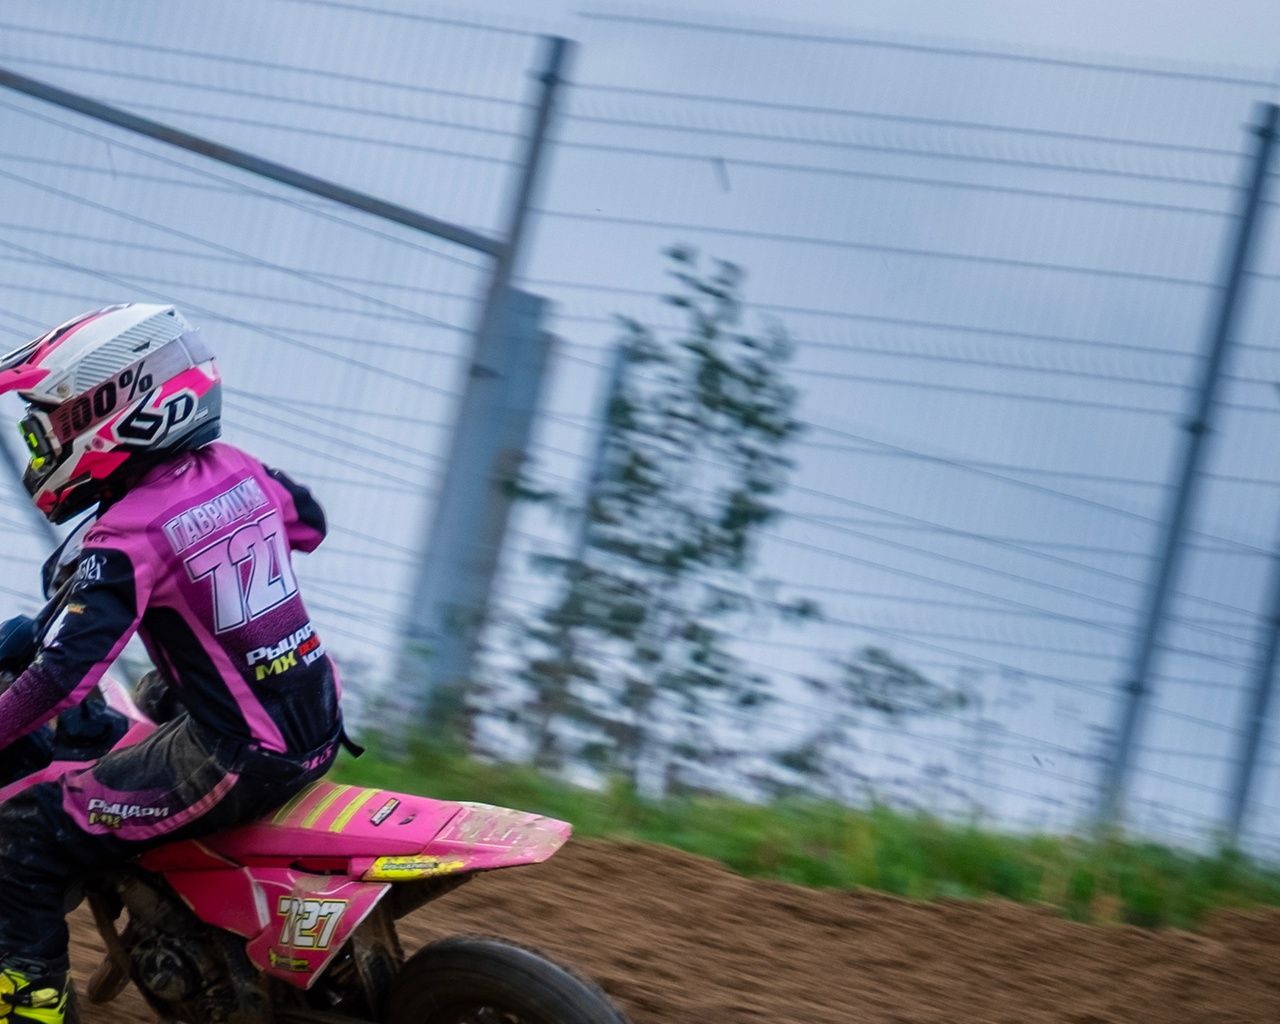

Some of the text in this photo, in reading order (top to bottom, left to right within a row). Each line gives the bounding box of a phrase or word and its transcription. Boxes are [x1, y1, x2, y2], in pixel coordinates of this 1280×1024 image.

[113, 386, 198, 448] 6D
[183, 508, 299, 635] 727
[246, 621, 314, 666] РЫЦАР
[278, 896, 349, 950] 727
